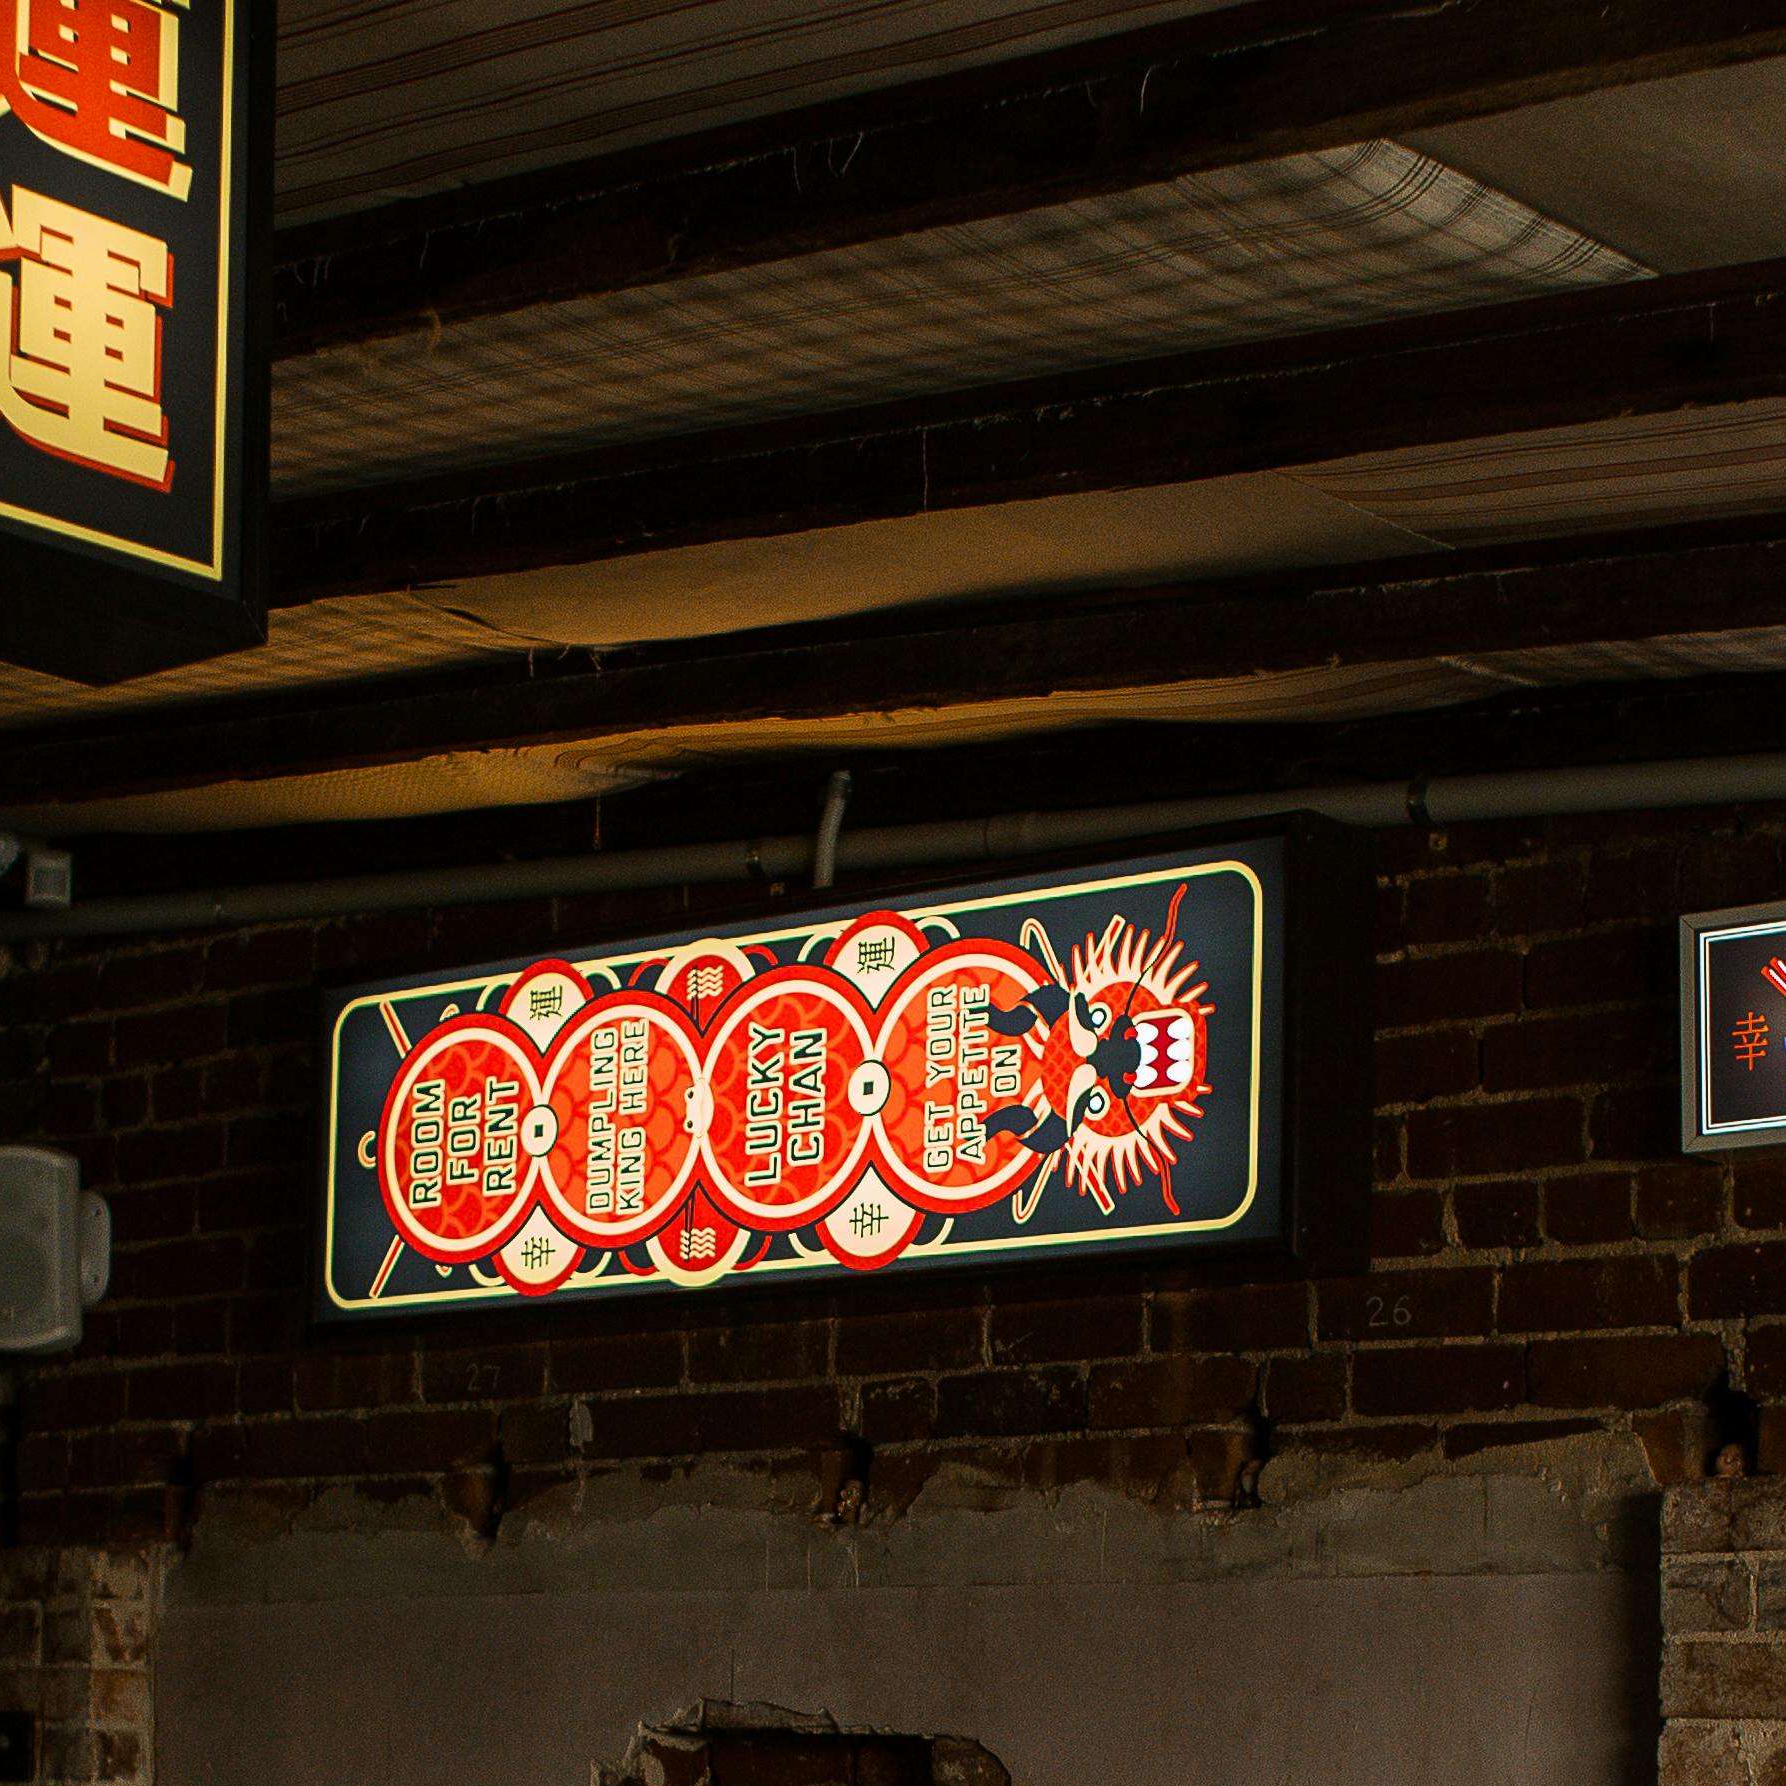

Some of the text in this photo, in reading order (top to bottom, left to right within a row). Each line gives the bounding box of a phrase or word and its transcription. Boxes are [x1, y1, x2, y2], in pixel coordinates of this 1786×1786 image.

[855, 935, 896, 975] 運
[529, 985, 564, 1021] 運
[1731, 1010, 1769, 1072] 幸
[745, 1025, 784, 1185] LUCKY
[788, 1029, 826, 1165] CHAN
[925, 986, 956, 1172] GET YOUR
[958, 984, 989, 1163] APPETITE
[993, 1045, 1021, 1097] ON
[410, 1080, 444, 1207] ROOM
[447, 1095, 480, 1183] FOR
[484, 1077, 518, 1195] RENT
[588, 1028, 617, 1212] DUMPLING
[618, 1018, 649, 1213] KING HERE
[520, 1234, 557, 1270] 幸
[848, 1201, 890, 1239] 幸
[1365, 1294, 1413, 1328] 26
[464, 1361, 502, 1392] 27
